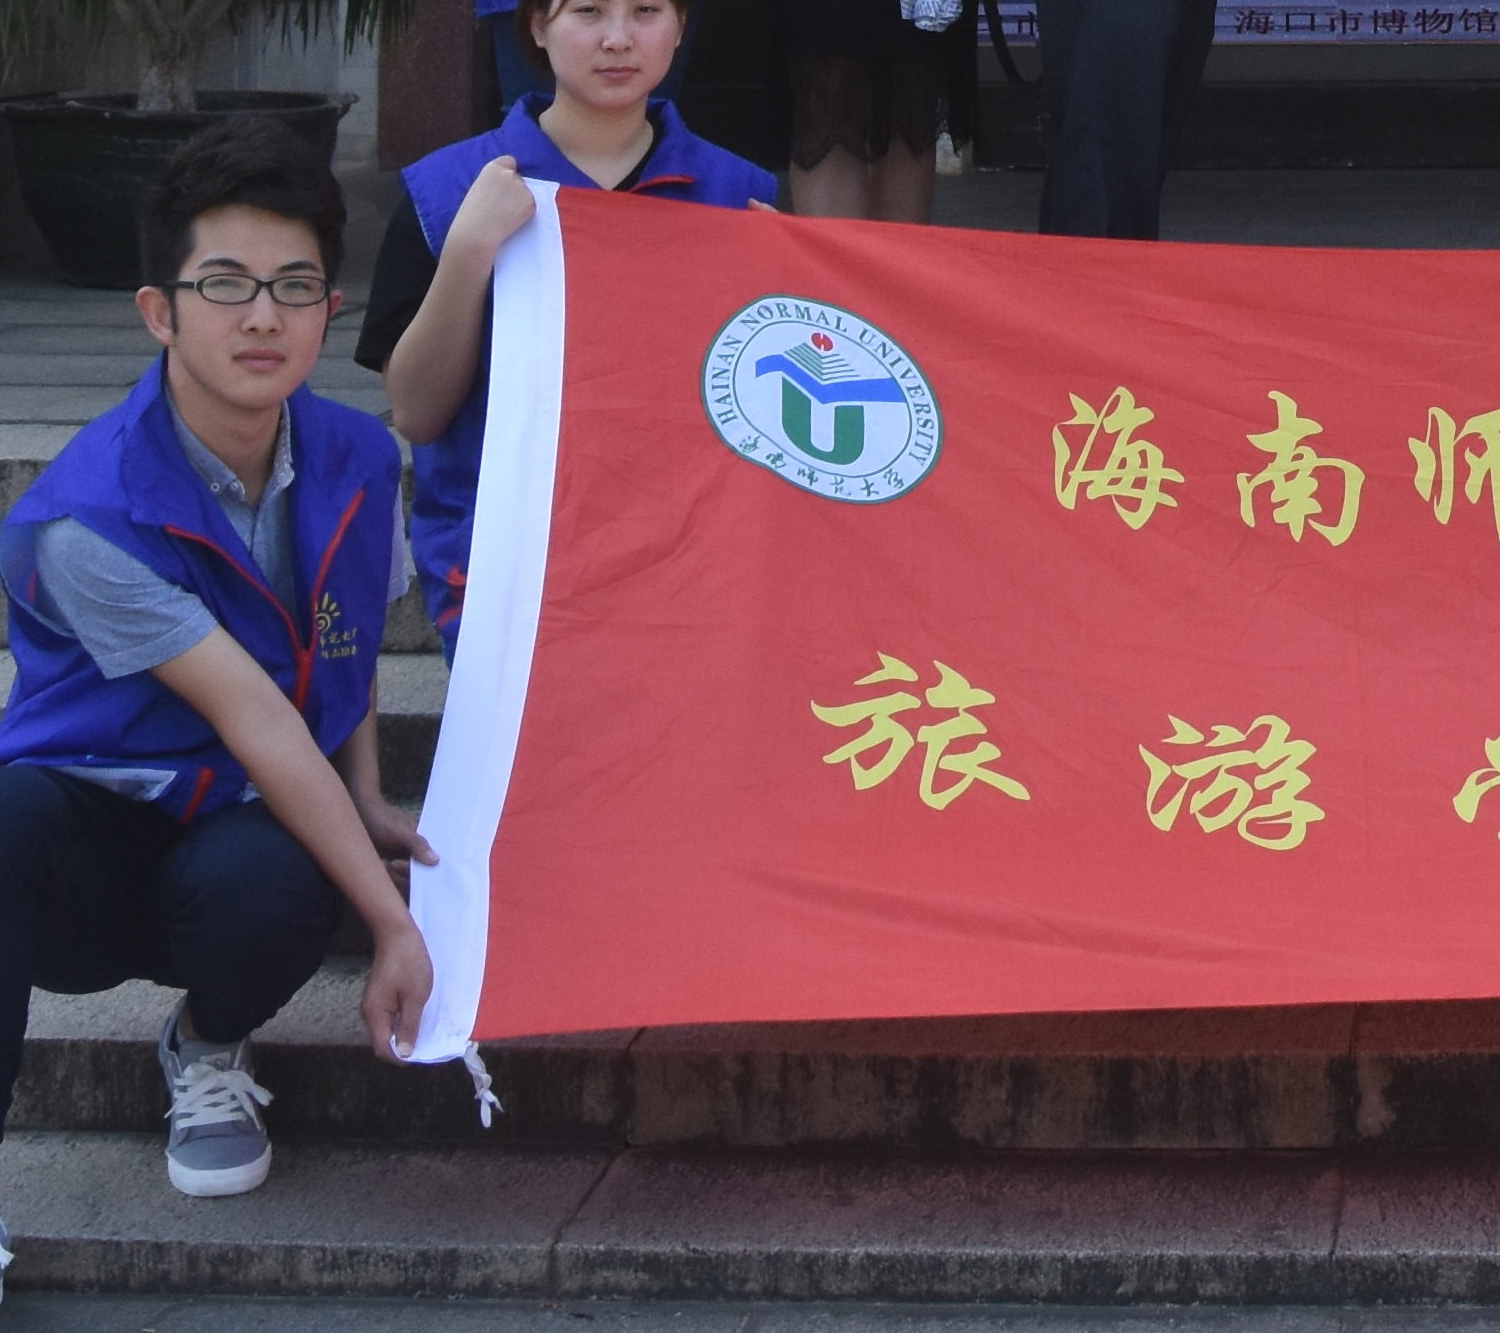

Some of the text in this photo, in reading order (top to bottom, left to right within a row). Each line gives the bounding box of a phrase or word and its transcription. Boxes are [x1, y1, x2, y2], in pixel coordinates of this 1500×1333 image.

[1234, 7, 1500, 35] 海口市博物馆
[710, 301, 936, 467] HAINAN NORMAL UNIVERSITY
